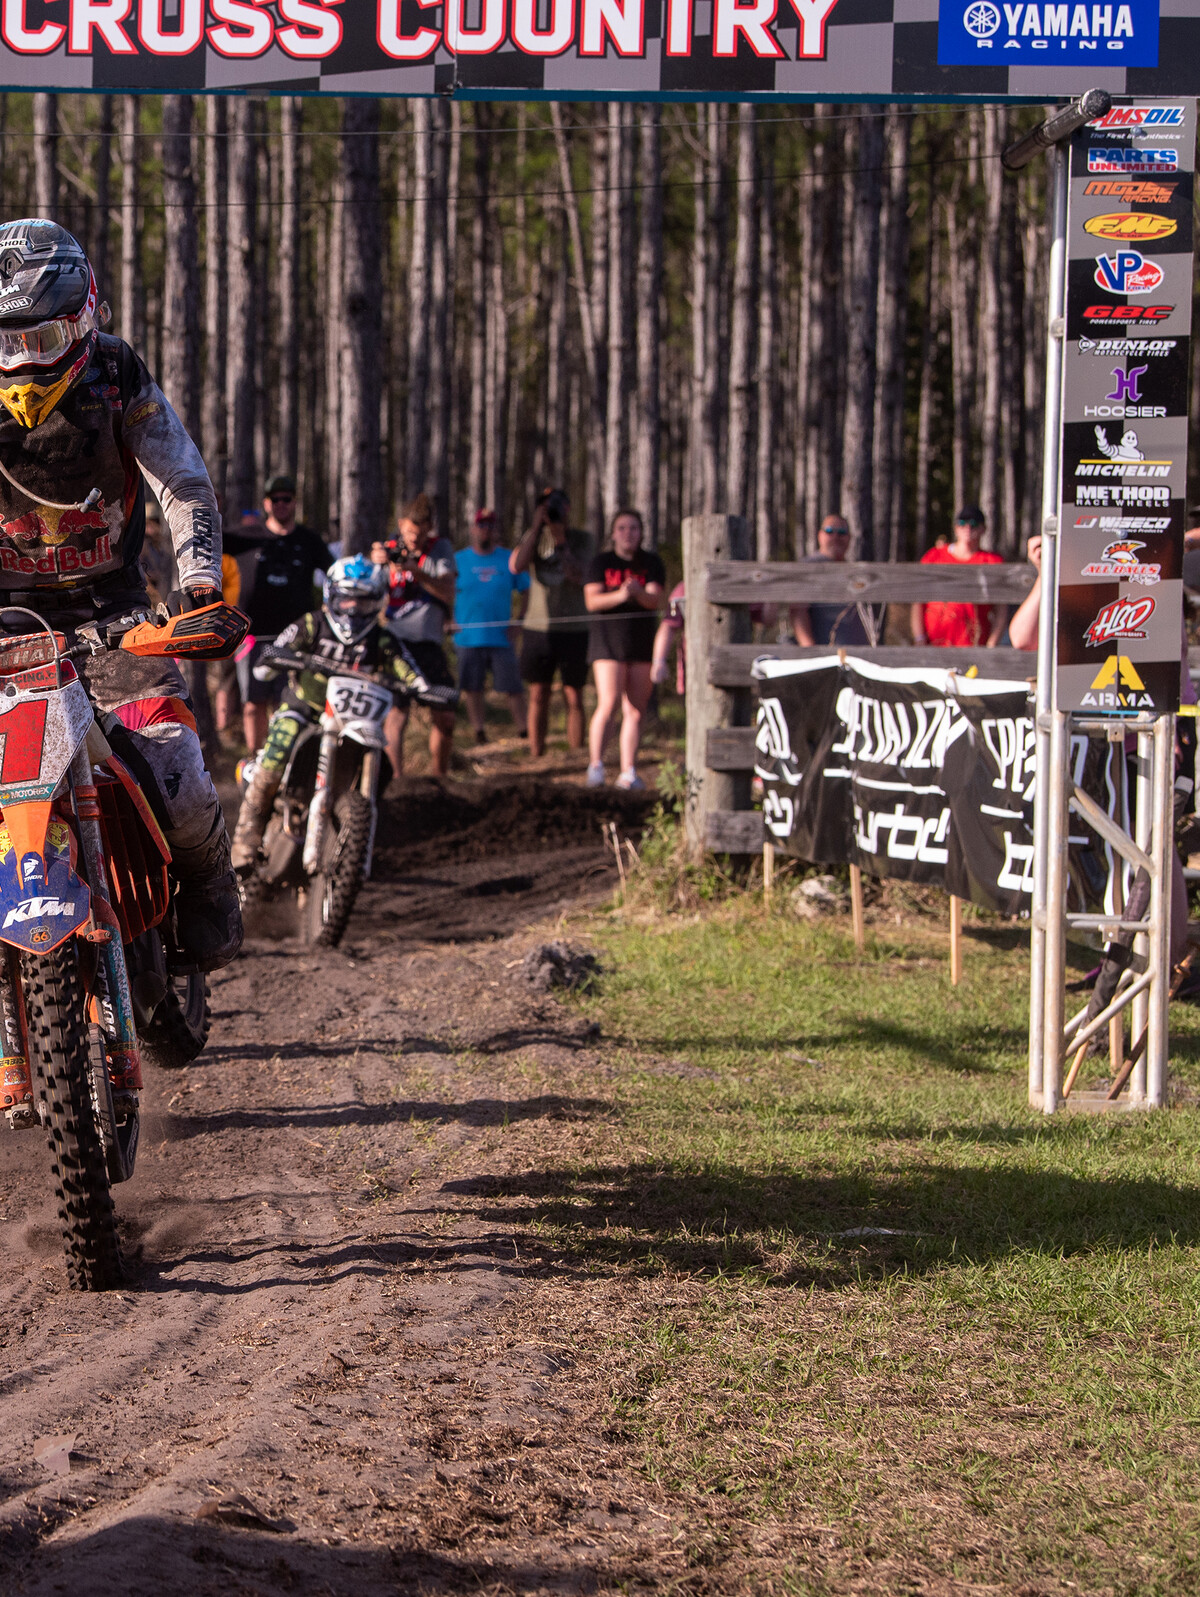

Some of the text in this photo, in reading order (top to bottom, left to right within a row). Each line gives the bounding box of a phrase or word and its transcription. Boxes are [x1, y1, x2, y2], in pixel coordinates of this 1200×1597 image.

[1004, 4, 1134, 38] YAMAHA
[1, 0, 345, 59] CROSS
[375, 0, 839, 60] COUNTRY
[976, 40, 1125, 50] RACING
[1089, 149, 1177, 162] PARTS
[1089, 163, 1177, 171] UNLIMITED
[1083, 181, 1179, 195] MOOSE
[1086, 216, 1177, 233] FMF
[1098, 253, 1142, 291] VP
[1082, 306, 1174, 318] GBC
[1096, 341, 1177, 351] DUNLOP
[1084, 406, 1167, 417] HOOSIER
[1075, 464, 1171, 477] MICHELIN
[1076, 485, 1170, 501] METHOD
[192, 508, 213, 561] THOR
[57, 534, 112, 573] Bull
[1085, 564, 1159, 574] ALL BALLS
[191, 589, 213, 599] THOR
[334, 688, 389, 722] 357
[1080, 692, 1155, 708] ARMA
[11, 786, 50, 799] MOTOREX
[23, 875, 43, 883] THOR
[2, 896, 76, 929] KTM
[32, 932, 49, 943] 66
